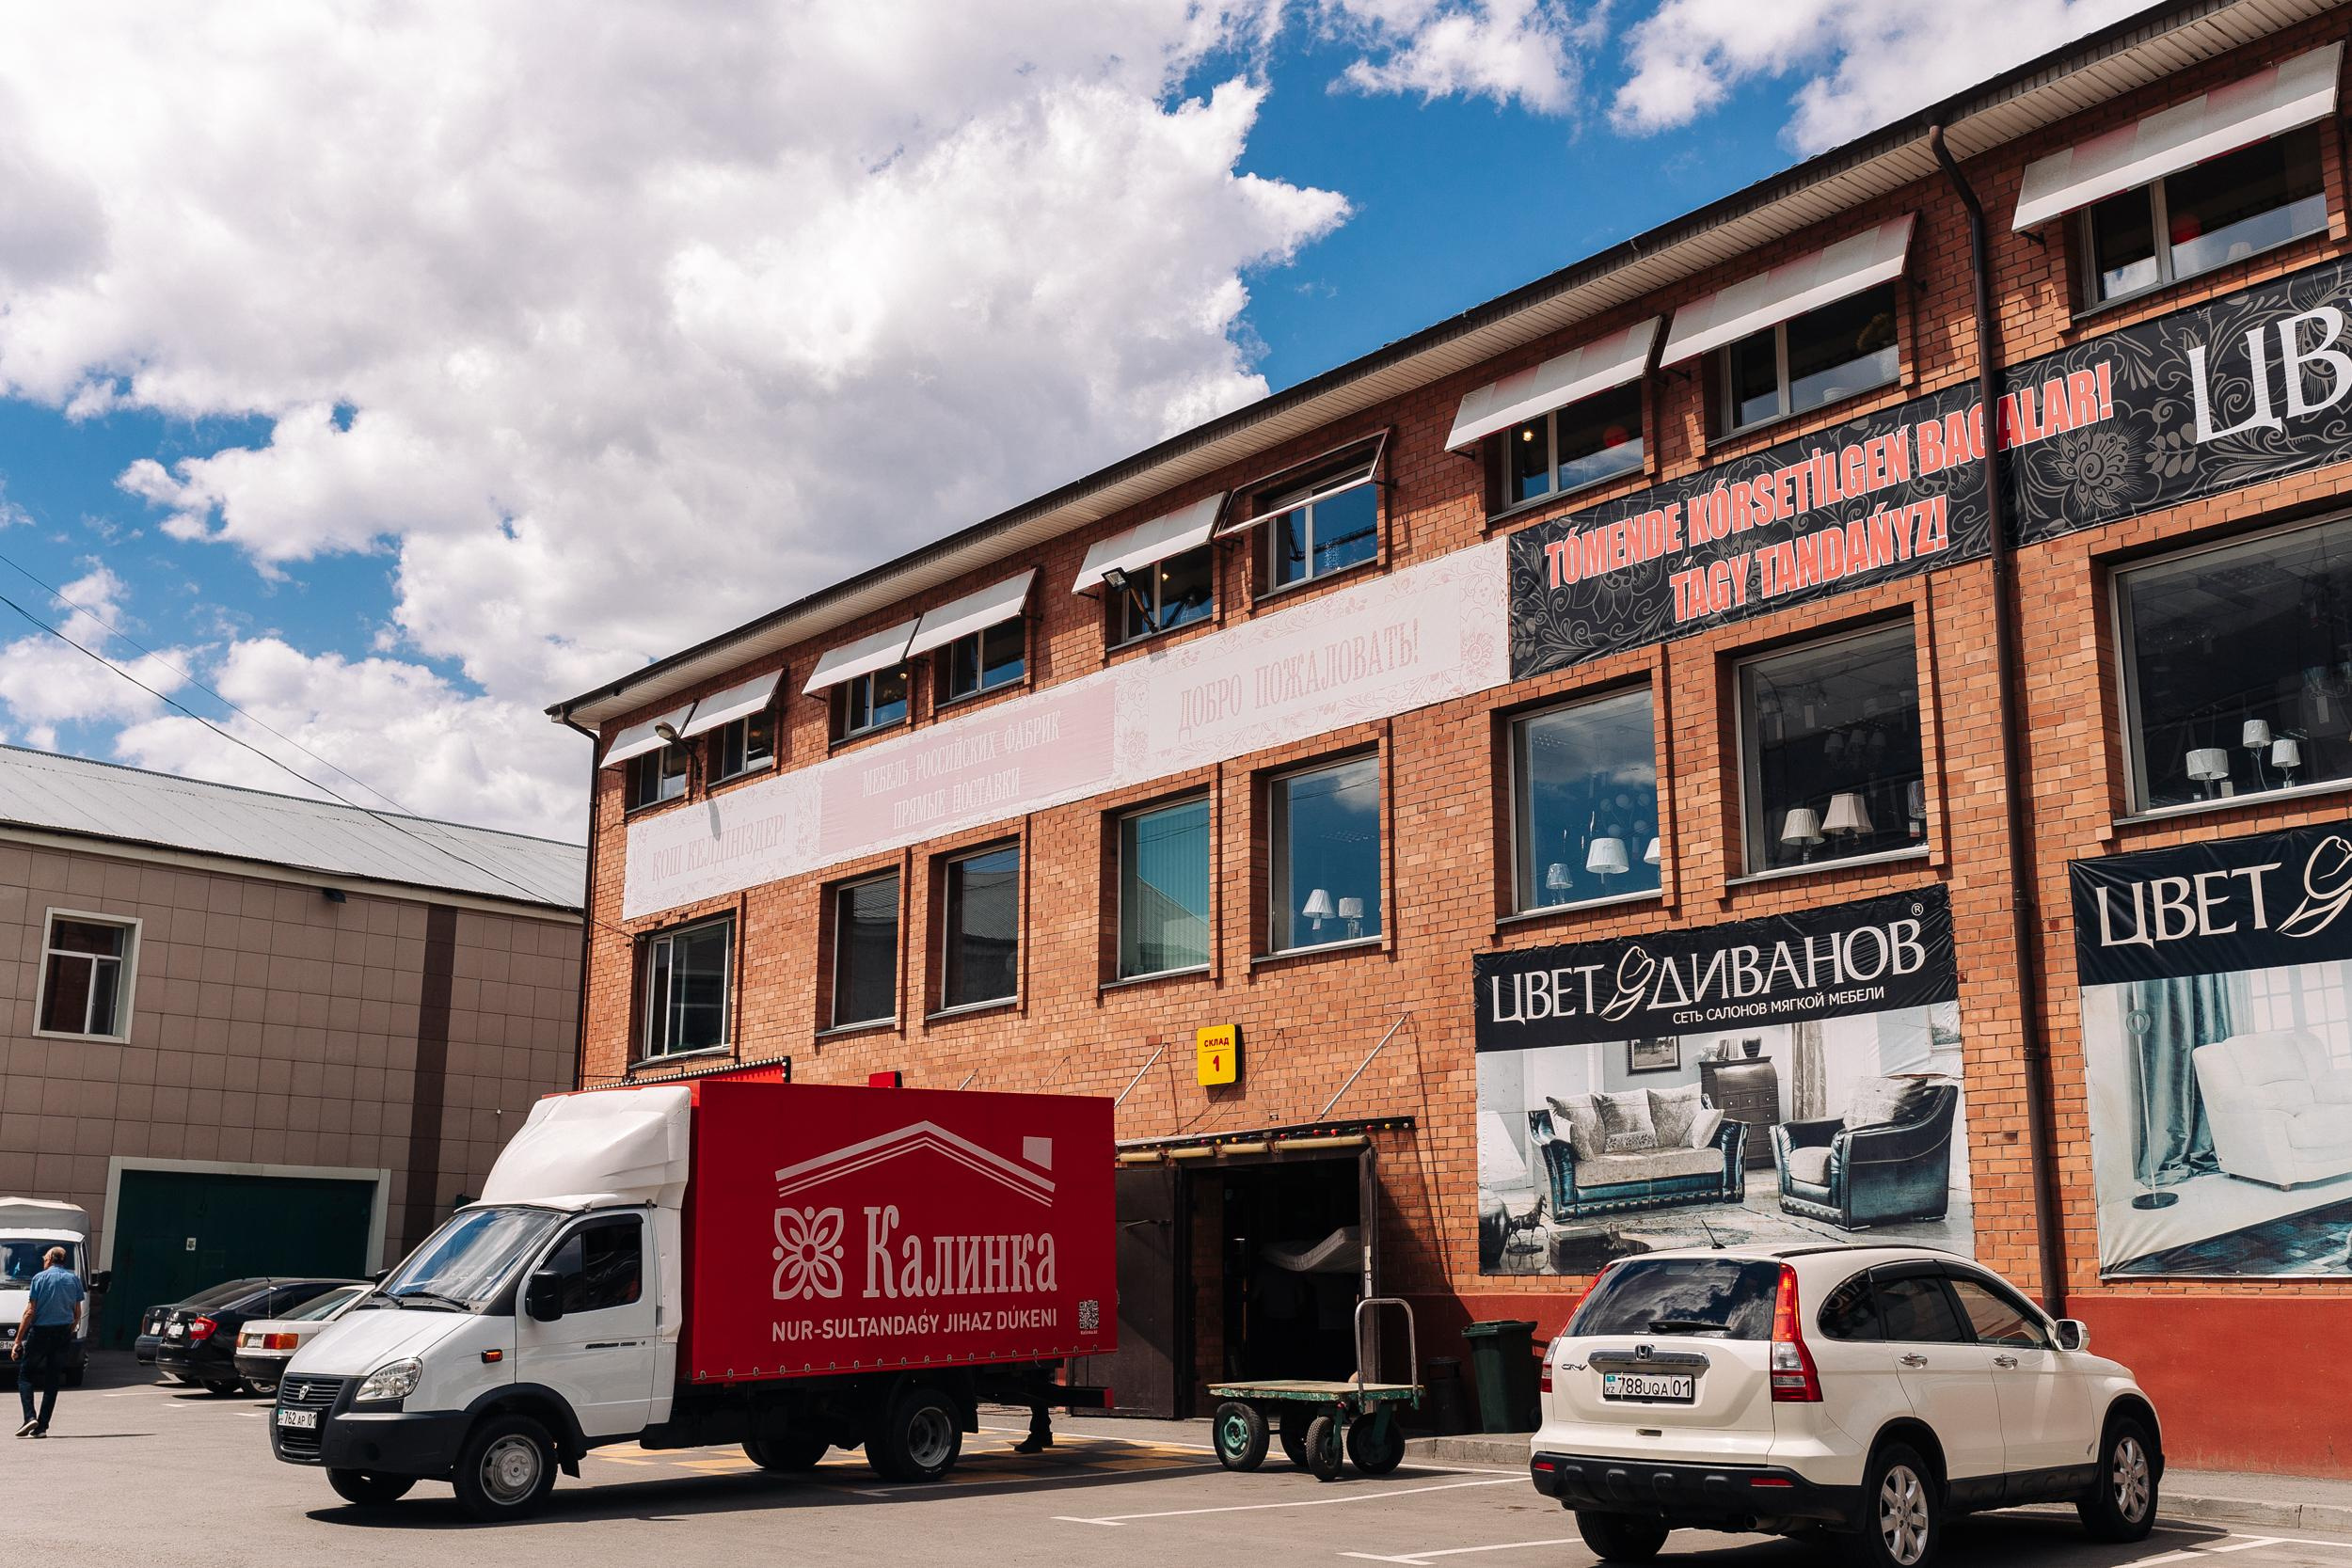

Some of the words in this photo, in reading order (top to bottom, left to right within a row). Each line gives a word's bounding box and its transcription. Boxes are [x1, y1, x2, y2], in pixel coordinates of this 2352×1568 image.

[2187, 298, 2352, 444] ЦВ
[1545, 502, 1682, 590] TÓMENDE
[1179, 673, 1242, 742] ДОБРО
[1255, 617, 1419, 709] ПОЖАЛОВАТЬ!
[863, 759, 909, 798] МЕБЕЛЬ
[916, 732, 996, 782] РОССИЙСКИХ
[1004, 710, 1061, 753] ФАБРИК
[893, 789, 946, 830] ПРЯМЫЕ
[953, 768, 1020, 813] ПОСТАВКИ
[2096, 862, 2281, 949] ЦВЕТ
[1491, 964, 1604, 1026] ЦВЕТ
[1647, 918, 1926, 1011] ДИВАНОВ
[1673, 1010, 1703, 1024] СЕТЬ
[1707, 1004, 1767, 1021] САЛОНОВ
[1771, 992, 1825, 1013] МЯГКОЙ
[1829, 986, 1884, 1006] МЕБЕЛИ
[1204, 1037, 1230, 1047] СКЛАД
[1213, 1054, 1219, 1072] 1
[862, 1204, 1057, 1299] Калинка
[944, 1311, 992, 1333] JIHAZ
[996, 1305, 1057, 1330] DÚKENI
[1672, 1379, 1691, 1397] 01
